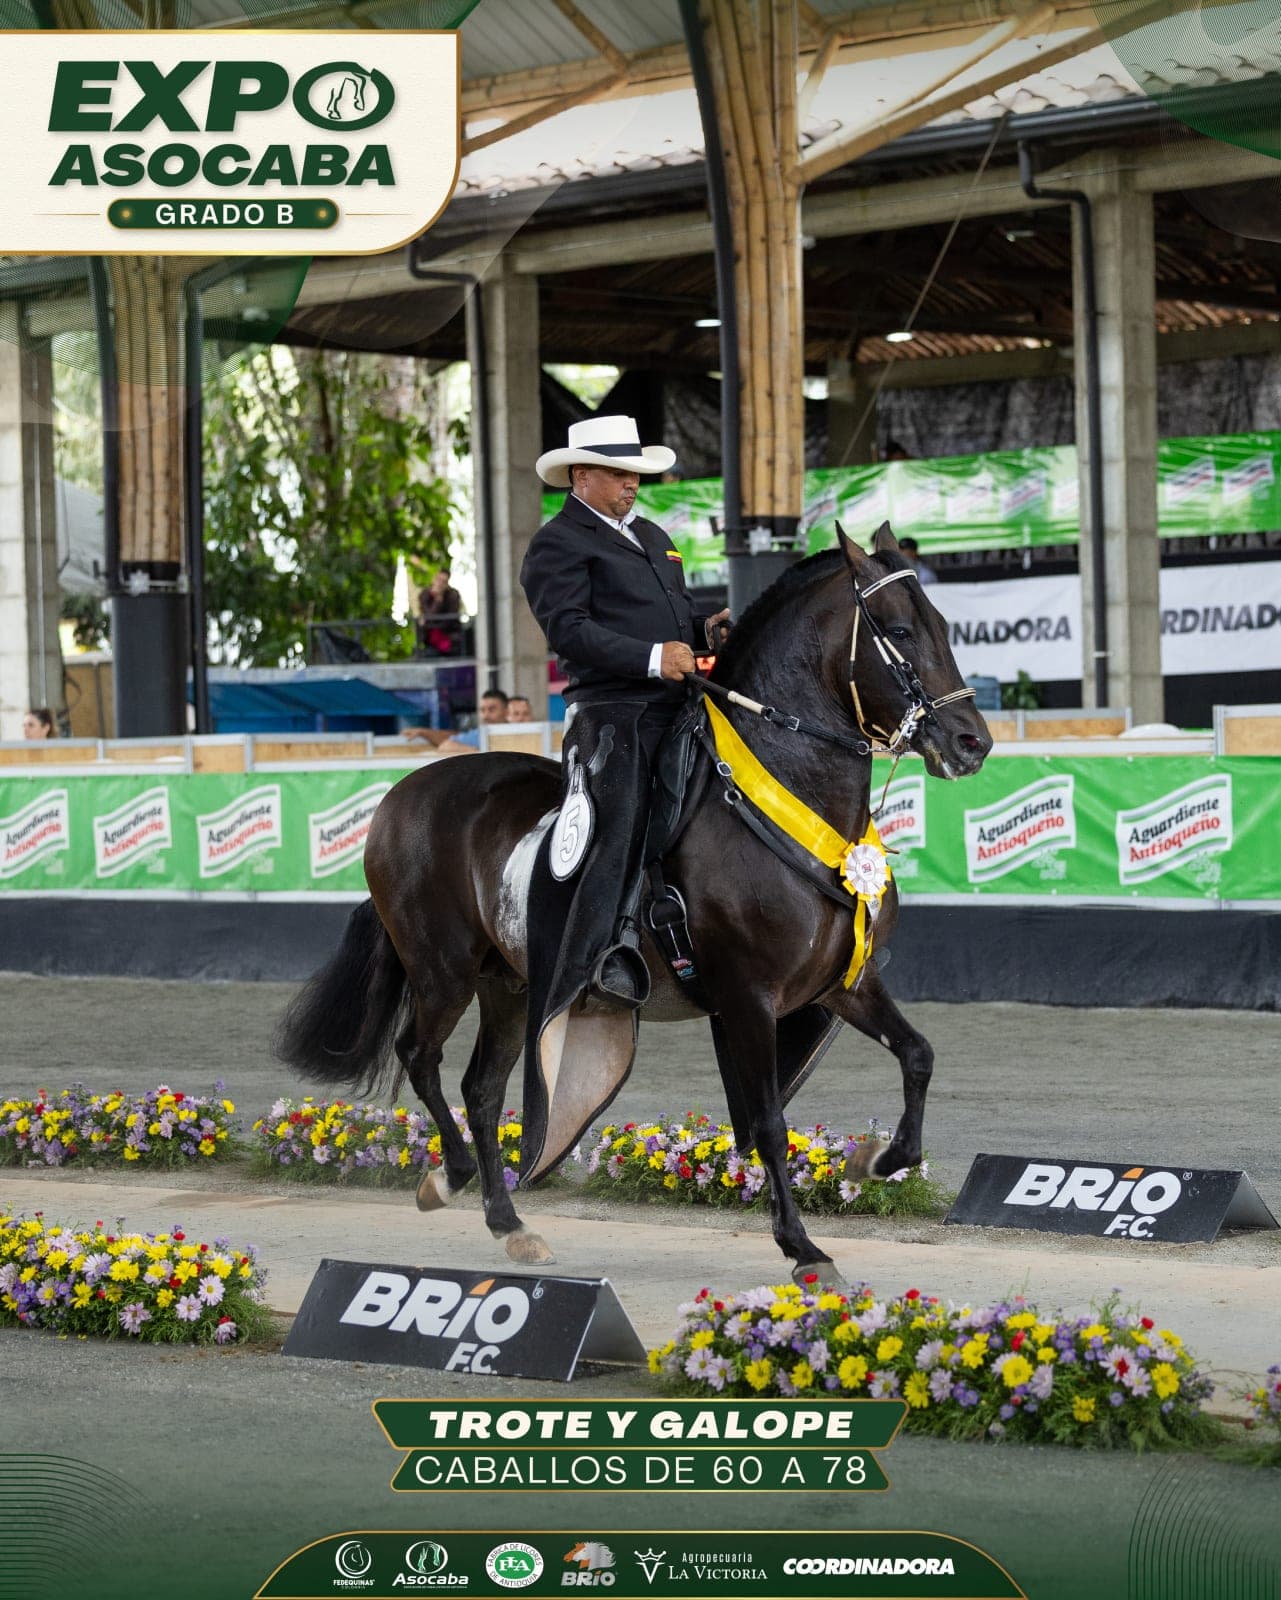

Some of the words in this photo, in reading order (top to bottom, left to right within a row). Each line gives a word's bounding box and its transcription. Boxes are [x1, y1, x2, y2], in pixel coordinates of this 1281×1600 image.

[560, 805, 580, 863] 5
[978, 798, 1063, 843] Aguardiente
[978, 812, 1065, 861] Antioqueño
[1129, 799, 1220, 845] Aguardiente
[1130, 813, 1221, 863] Antioqueño
[1103, 1214, 1158, 1239] F.C.
[444, 1342, 501, 1375] F.C.
